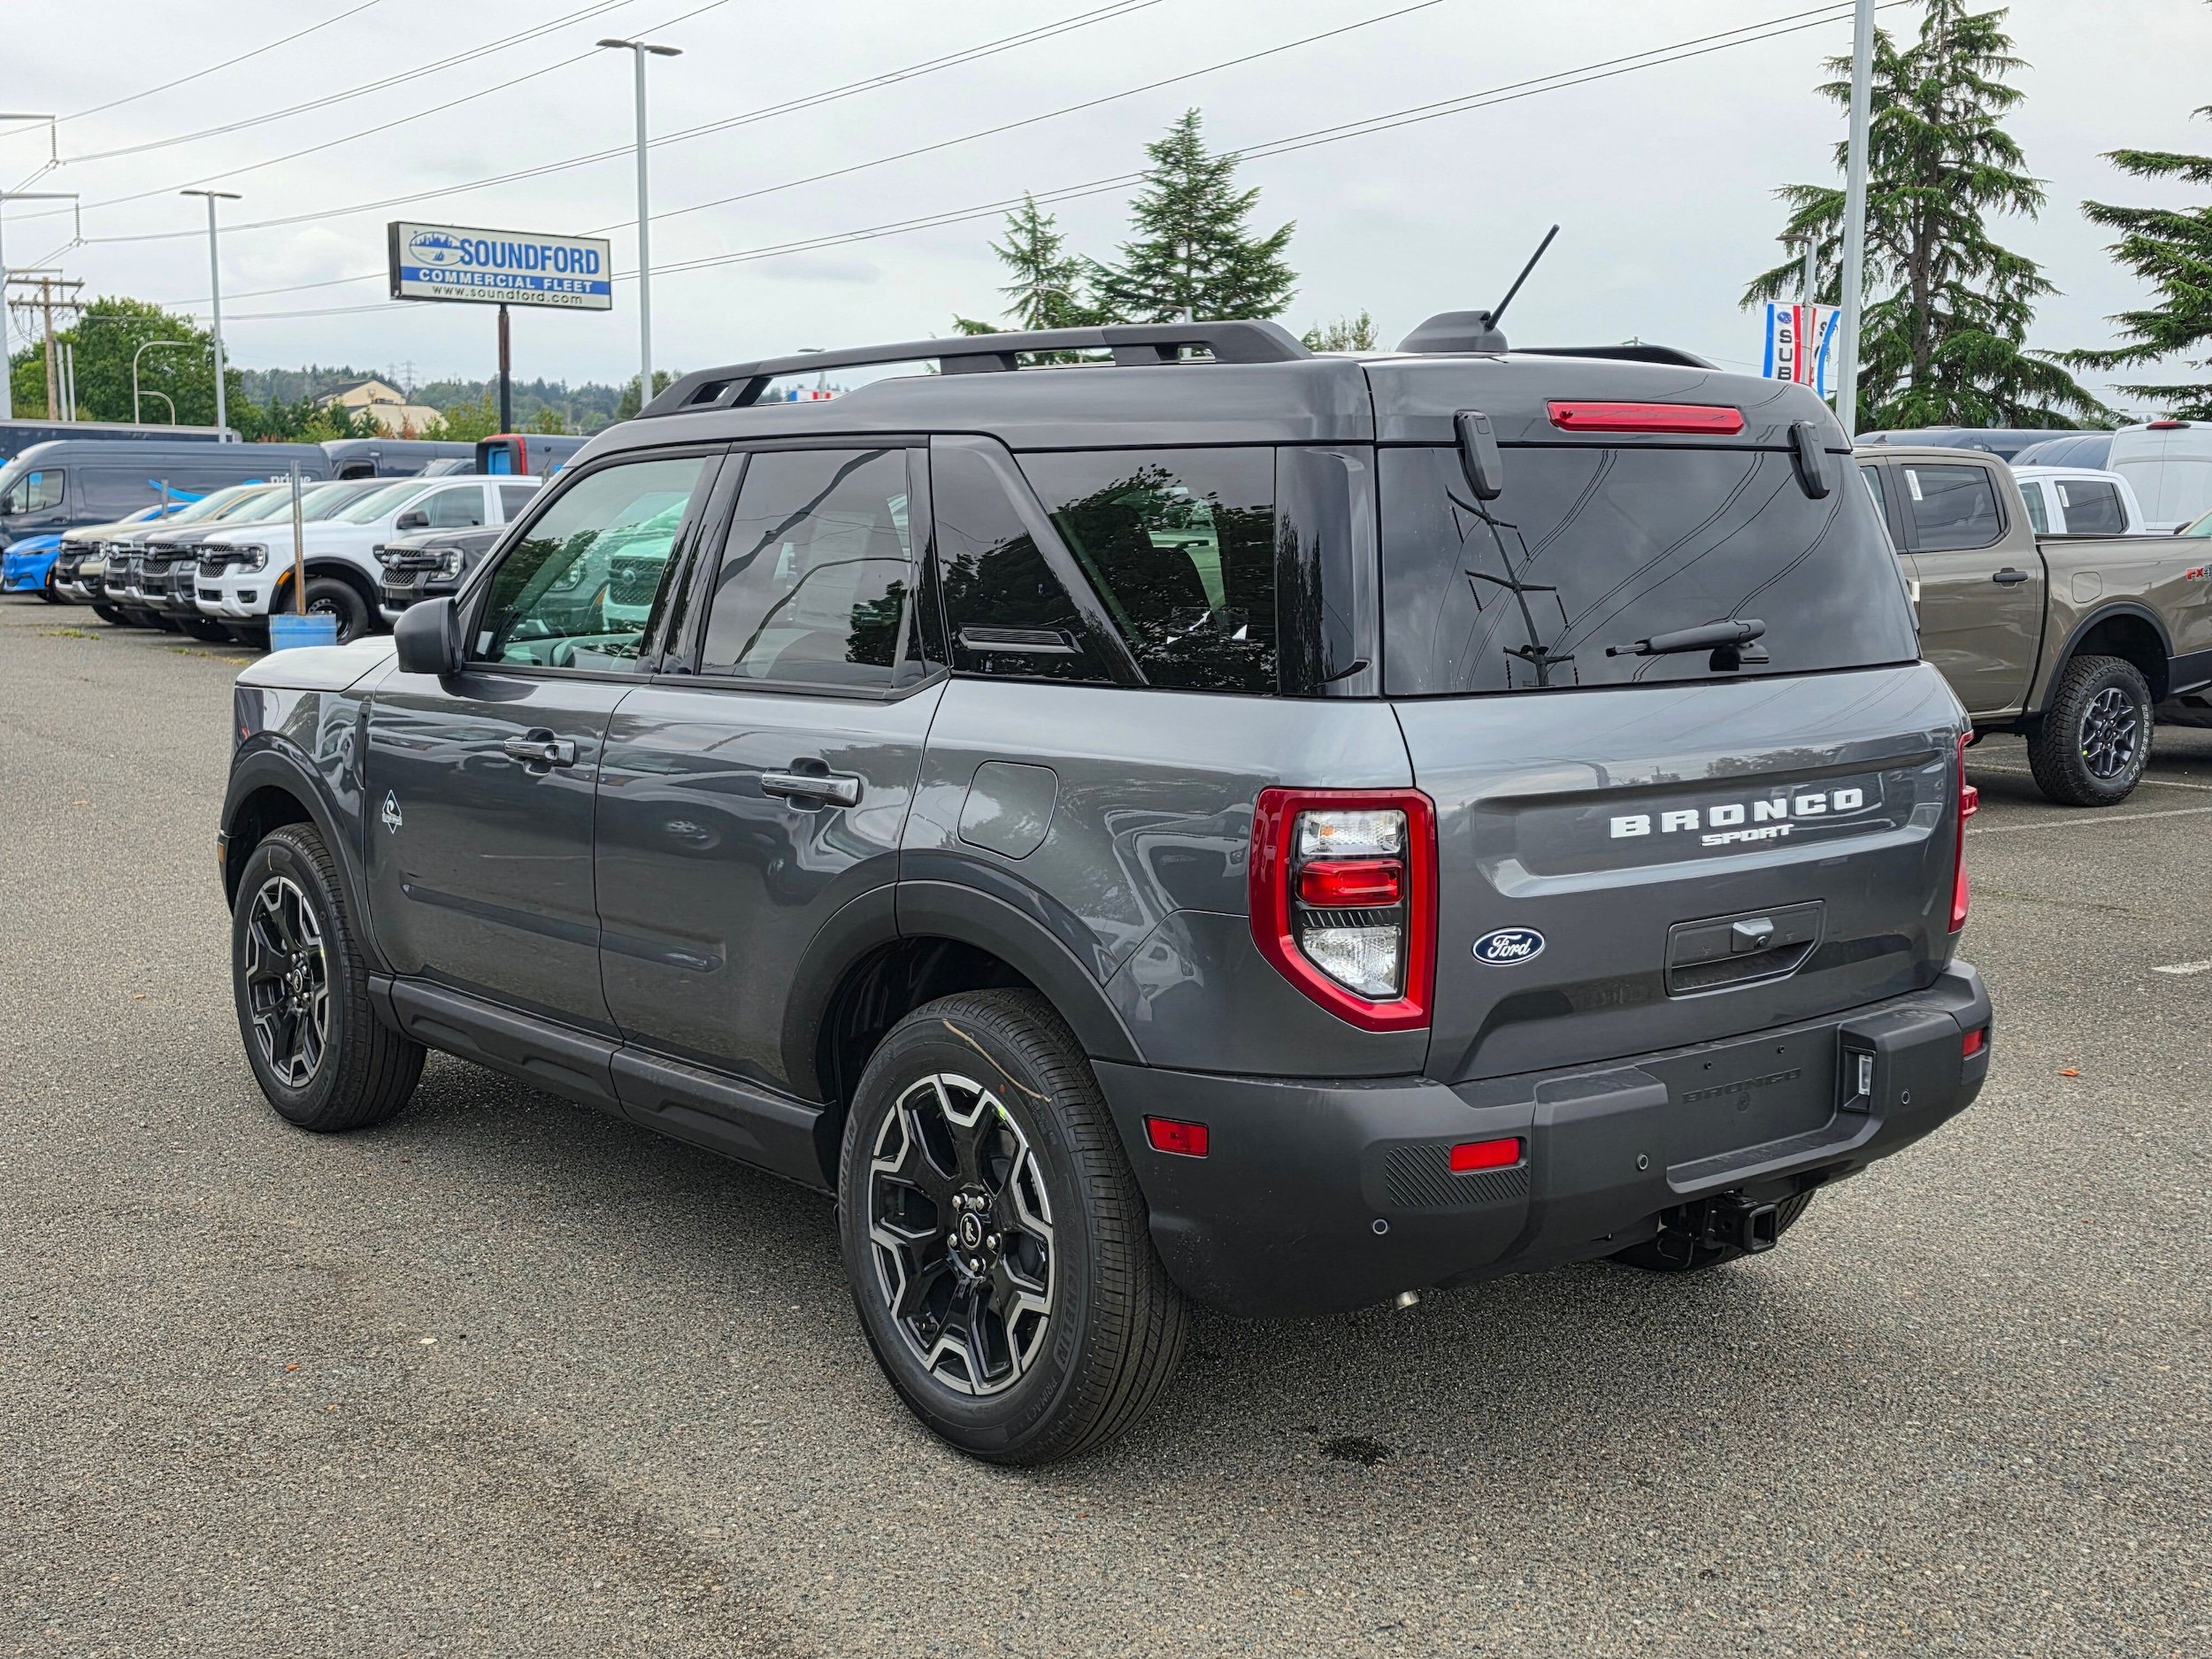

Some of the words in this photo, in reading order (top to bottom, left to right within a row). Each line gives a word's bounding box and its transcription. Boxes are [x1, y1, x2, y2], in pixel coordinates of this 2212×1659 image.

[459, 238, 600, 274] SOUNDFORD
[419, 268, 534, 289] COMMERCIAL
[542, 279, 593, 293] FLEET
[431, 284, 583, 305] www.soundford.com
[1609, 787, 1863, 839] BRONCO
[1701, 823, 1795, 847] SPORT
[1486, 933, 1532, 959] Ford
